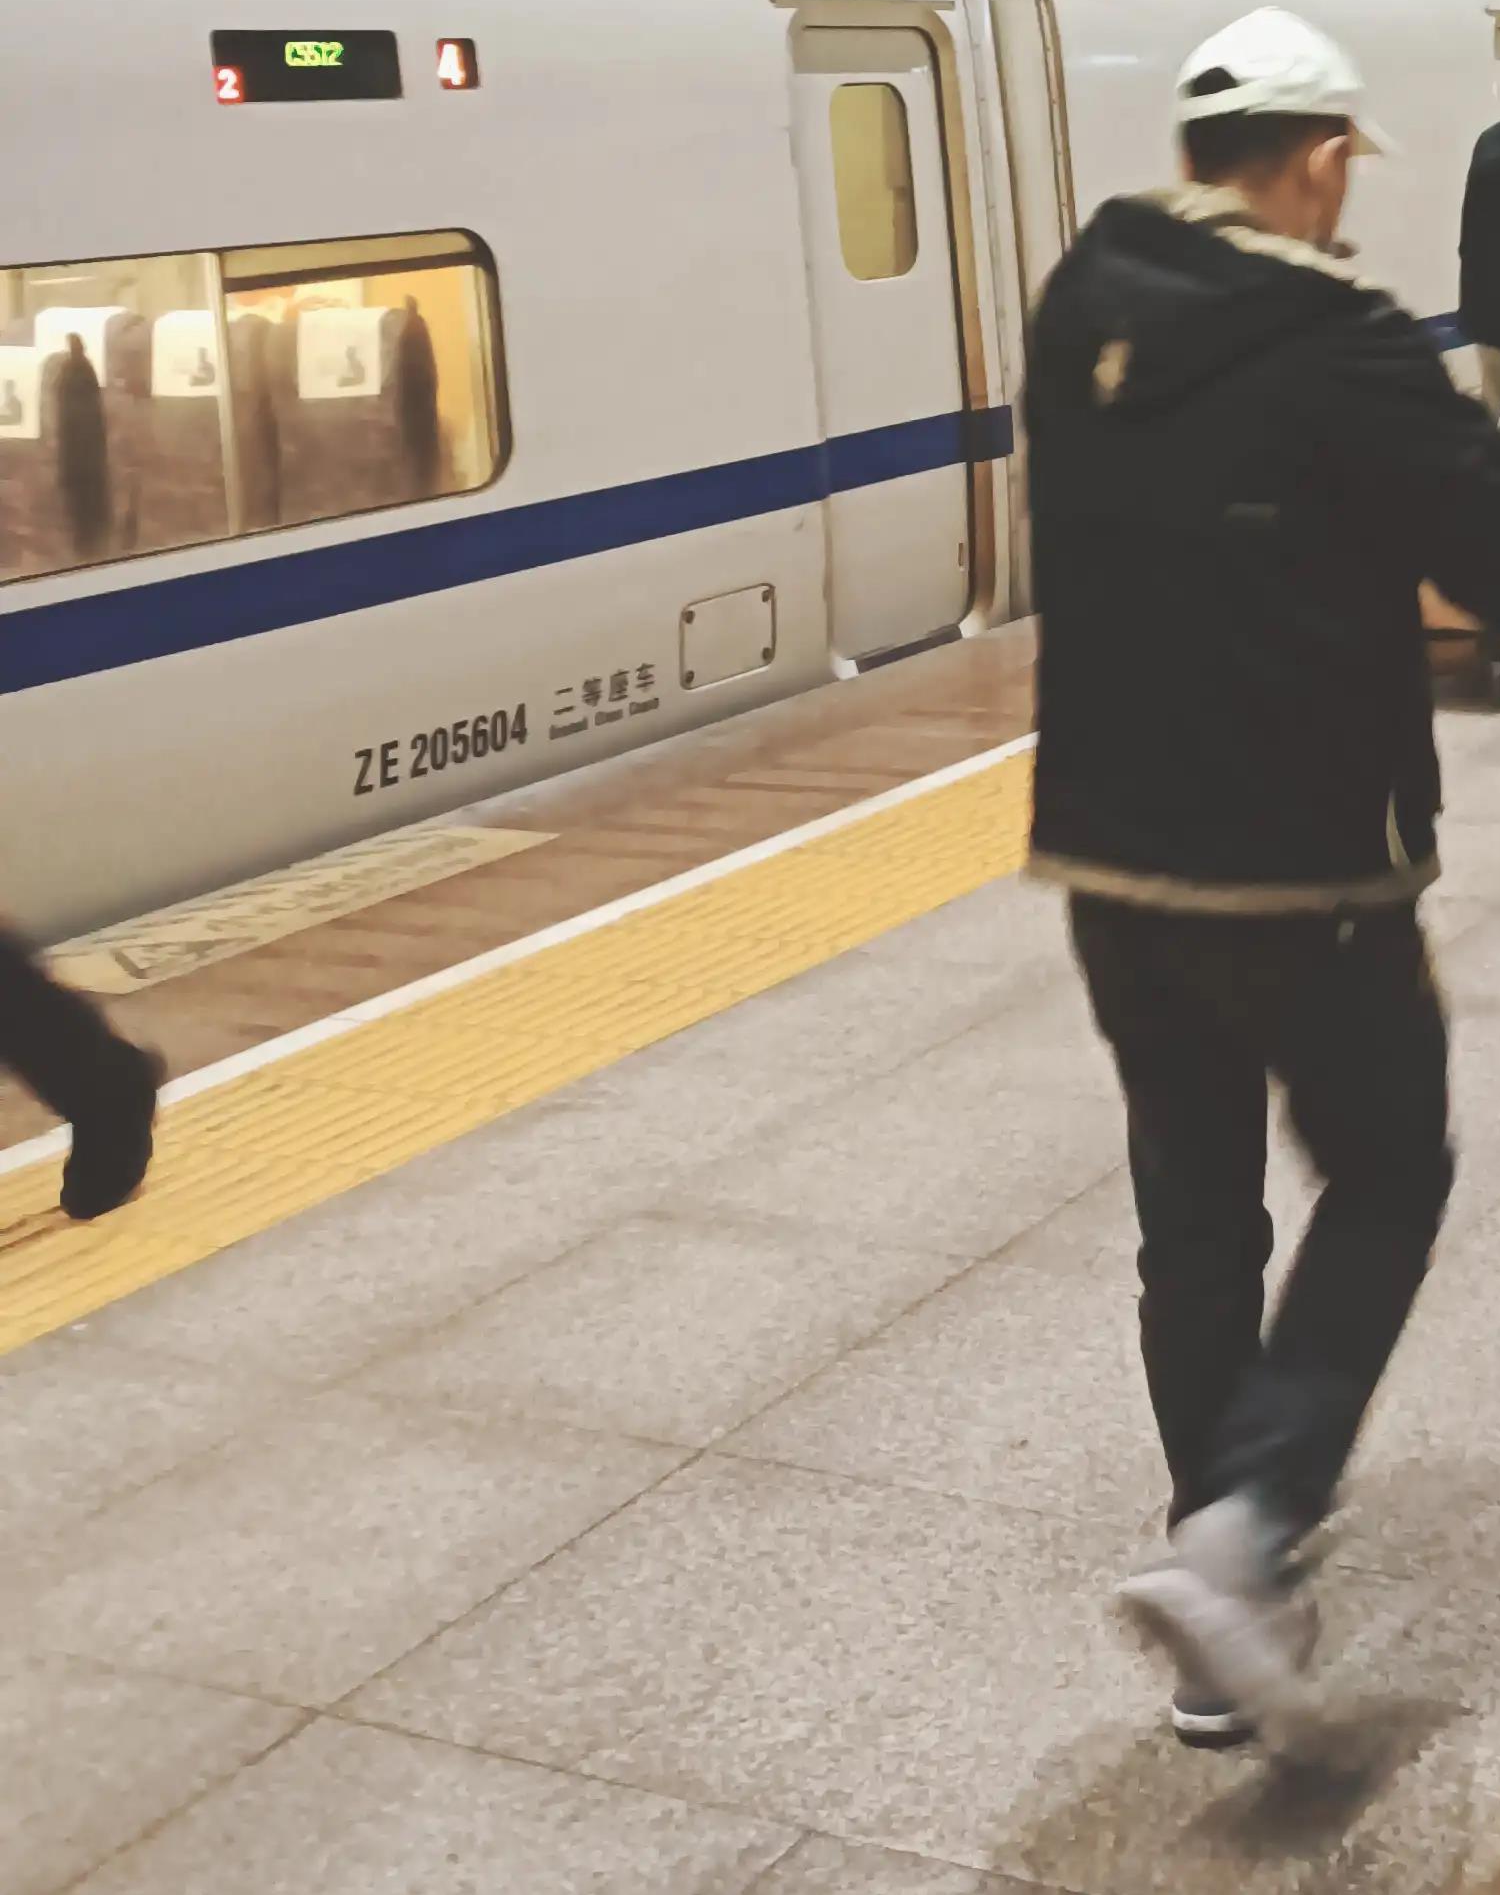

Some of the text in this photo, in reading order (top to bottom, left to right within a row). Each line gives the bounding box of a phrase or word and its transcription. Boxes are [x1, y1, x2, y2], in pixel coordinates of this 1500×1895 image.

[218, 68, 240, 99] 2
[437, 43, 466, 86] 4
[552, 662, 656, 715] 二等座车
[410, 703, 527, 778] 205604
